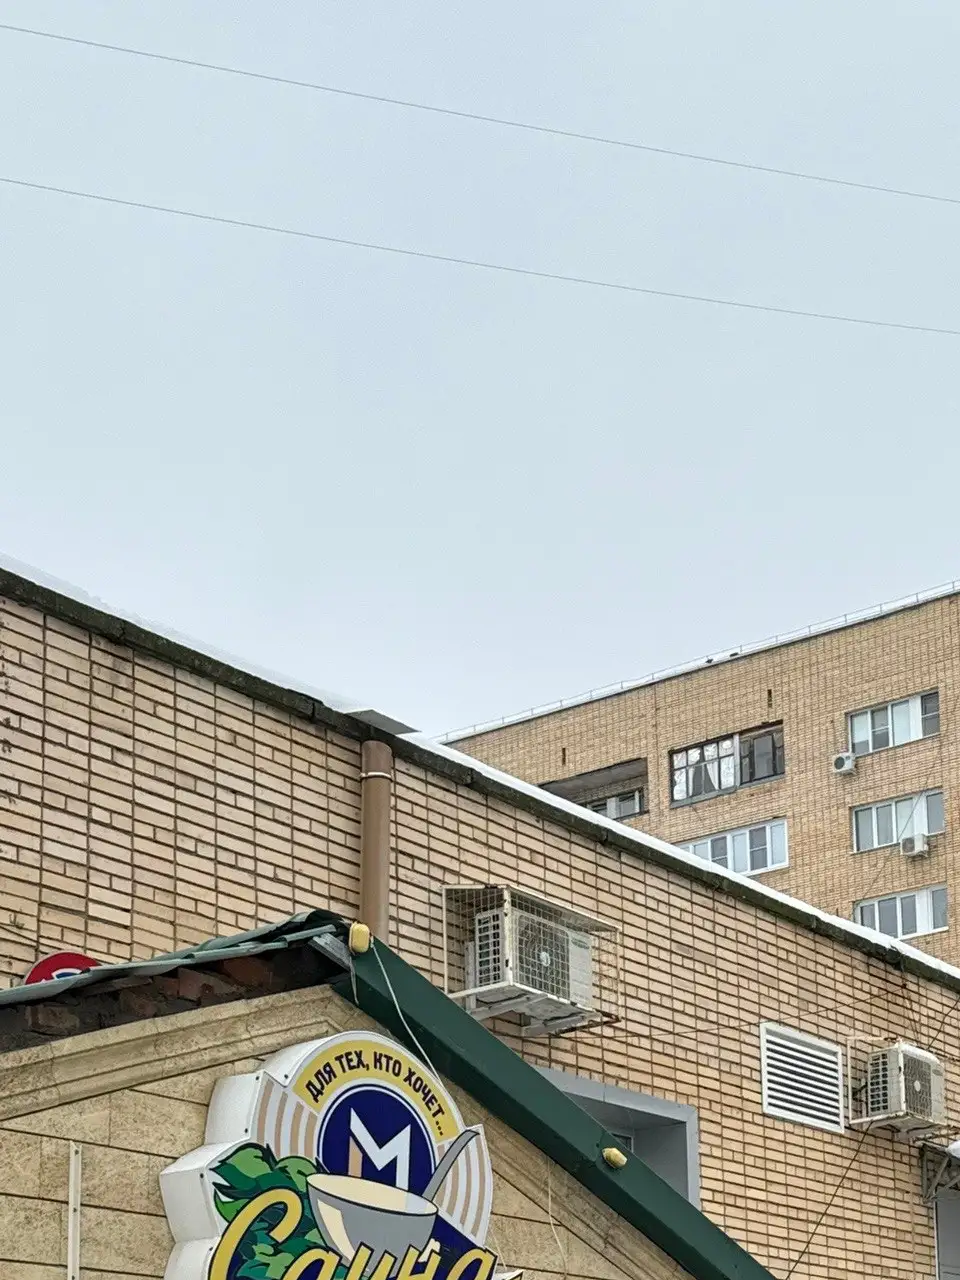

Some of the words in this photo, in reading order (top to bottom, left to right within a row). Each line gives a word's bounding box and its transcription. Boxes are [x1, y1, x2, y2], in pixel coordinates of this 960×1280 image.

[305, 1061, 338, 1103] ДЛЯ
[334, 1050, 371, 1074] ТЕХ,
[373, 1052, 402, 1077] КТО
[402, 1066, 445, 1136] ХОЧЕТ...
